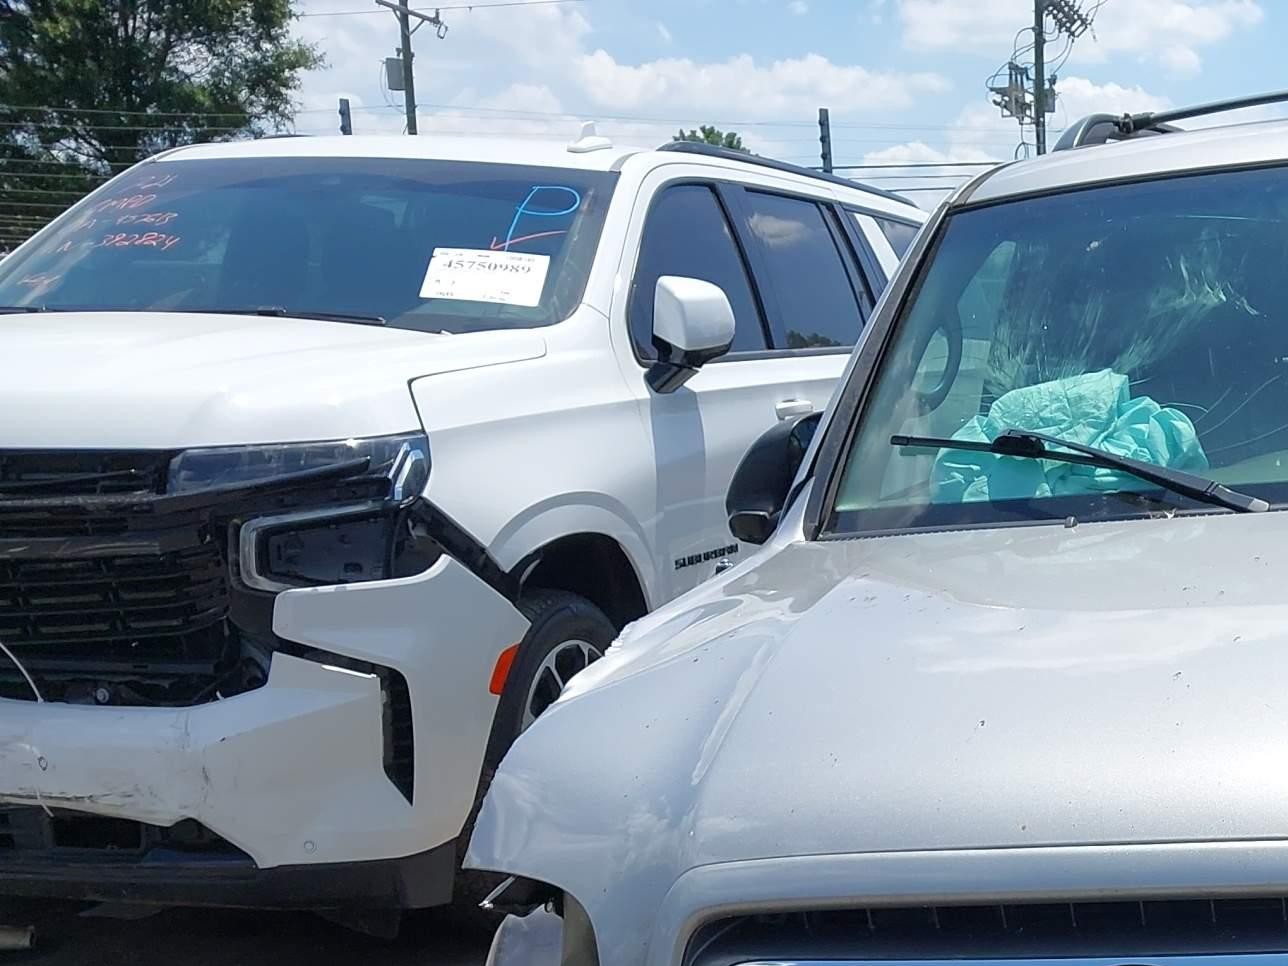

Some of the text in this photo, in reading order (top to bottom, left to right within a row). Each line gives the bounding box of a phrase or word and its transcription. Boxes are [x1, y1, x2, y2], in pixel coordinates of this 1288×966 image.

[505, 185, 581, 252] P
[442, 259, 533, 275] 45750989
[674, 543, 739, 570] SUBURBAN
